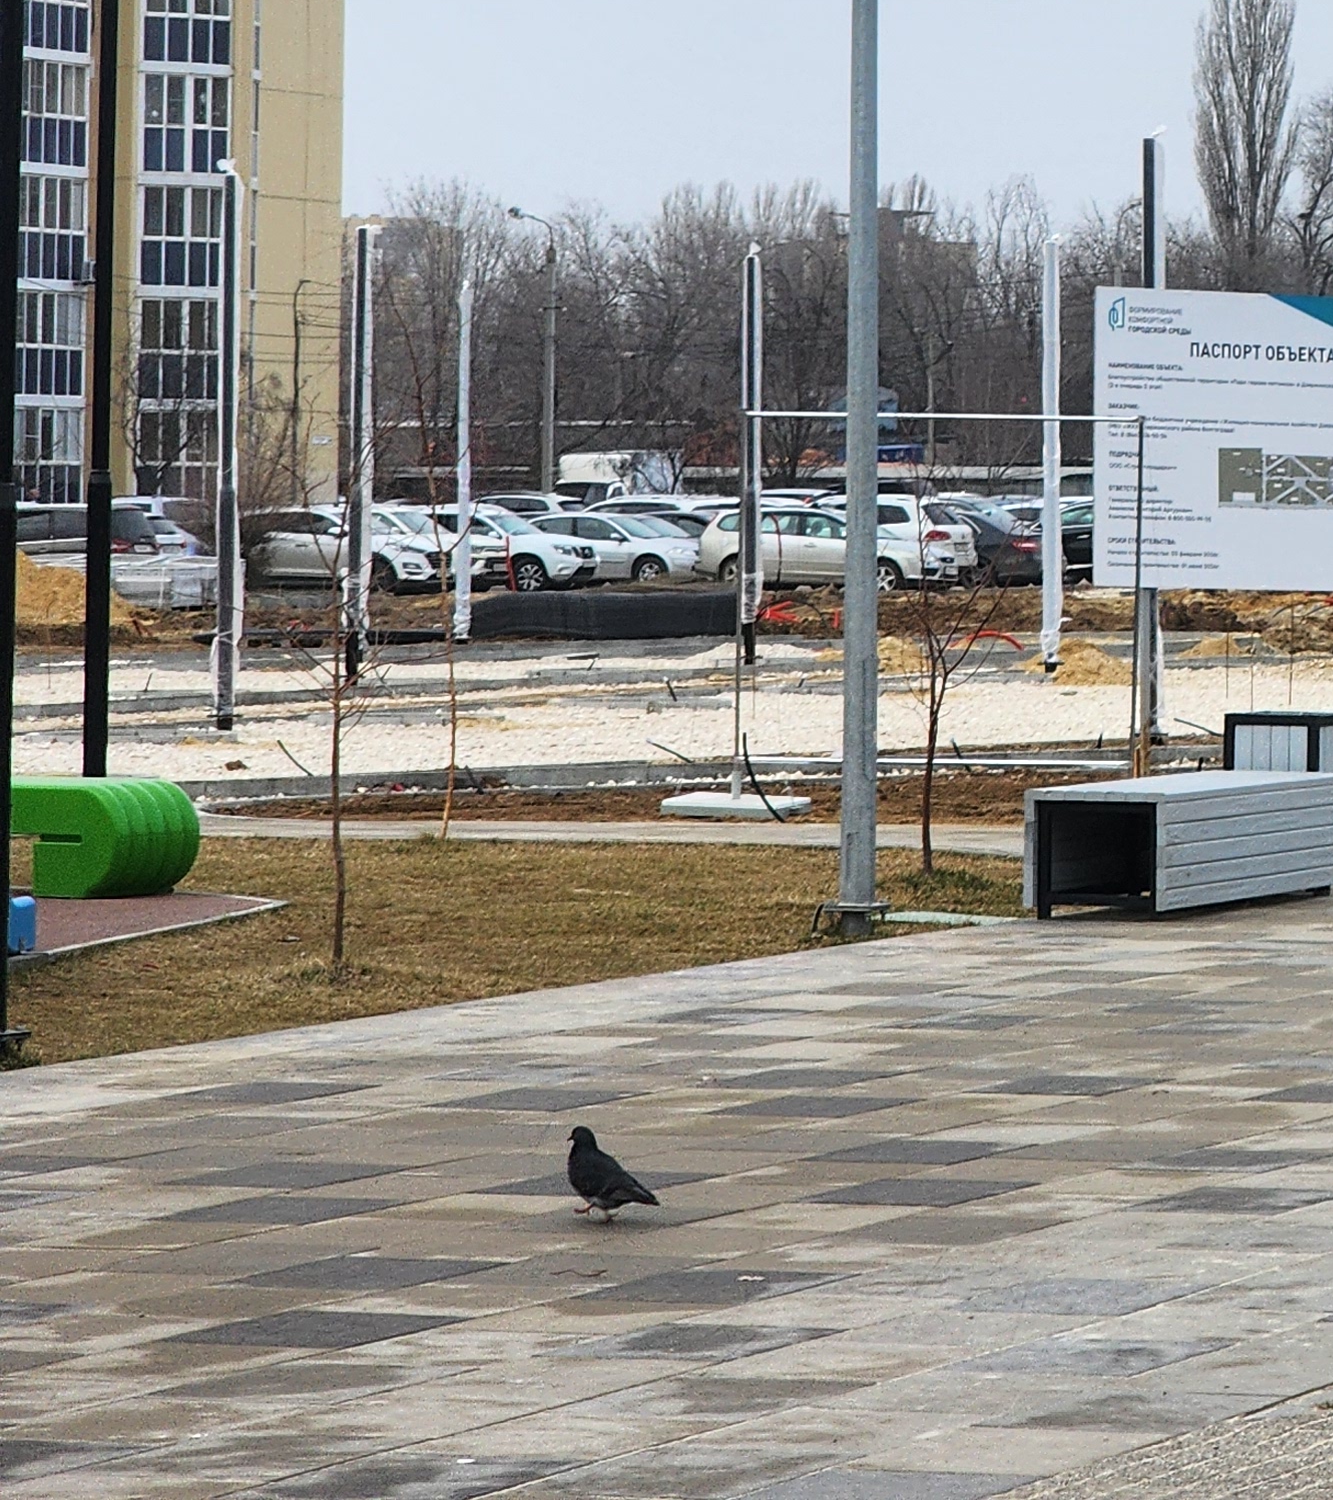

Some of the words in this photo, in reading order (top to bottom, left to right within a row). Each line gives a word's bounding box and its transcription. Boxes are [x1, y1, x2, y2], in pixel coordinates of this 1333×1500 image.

[1128, 325, 1167, 334] ГОРОДСКОЙ
[1168, 327, 1192, 336] СРЕДЫ
[1190, 342, 1261, 360] ПАСПОРТ
